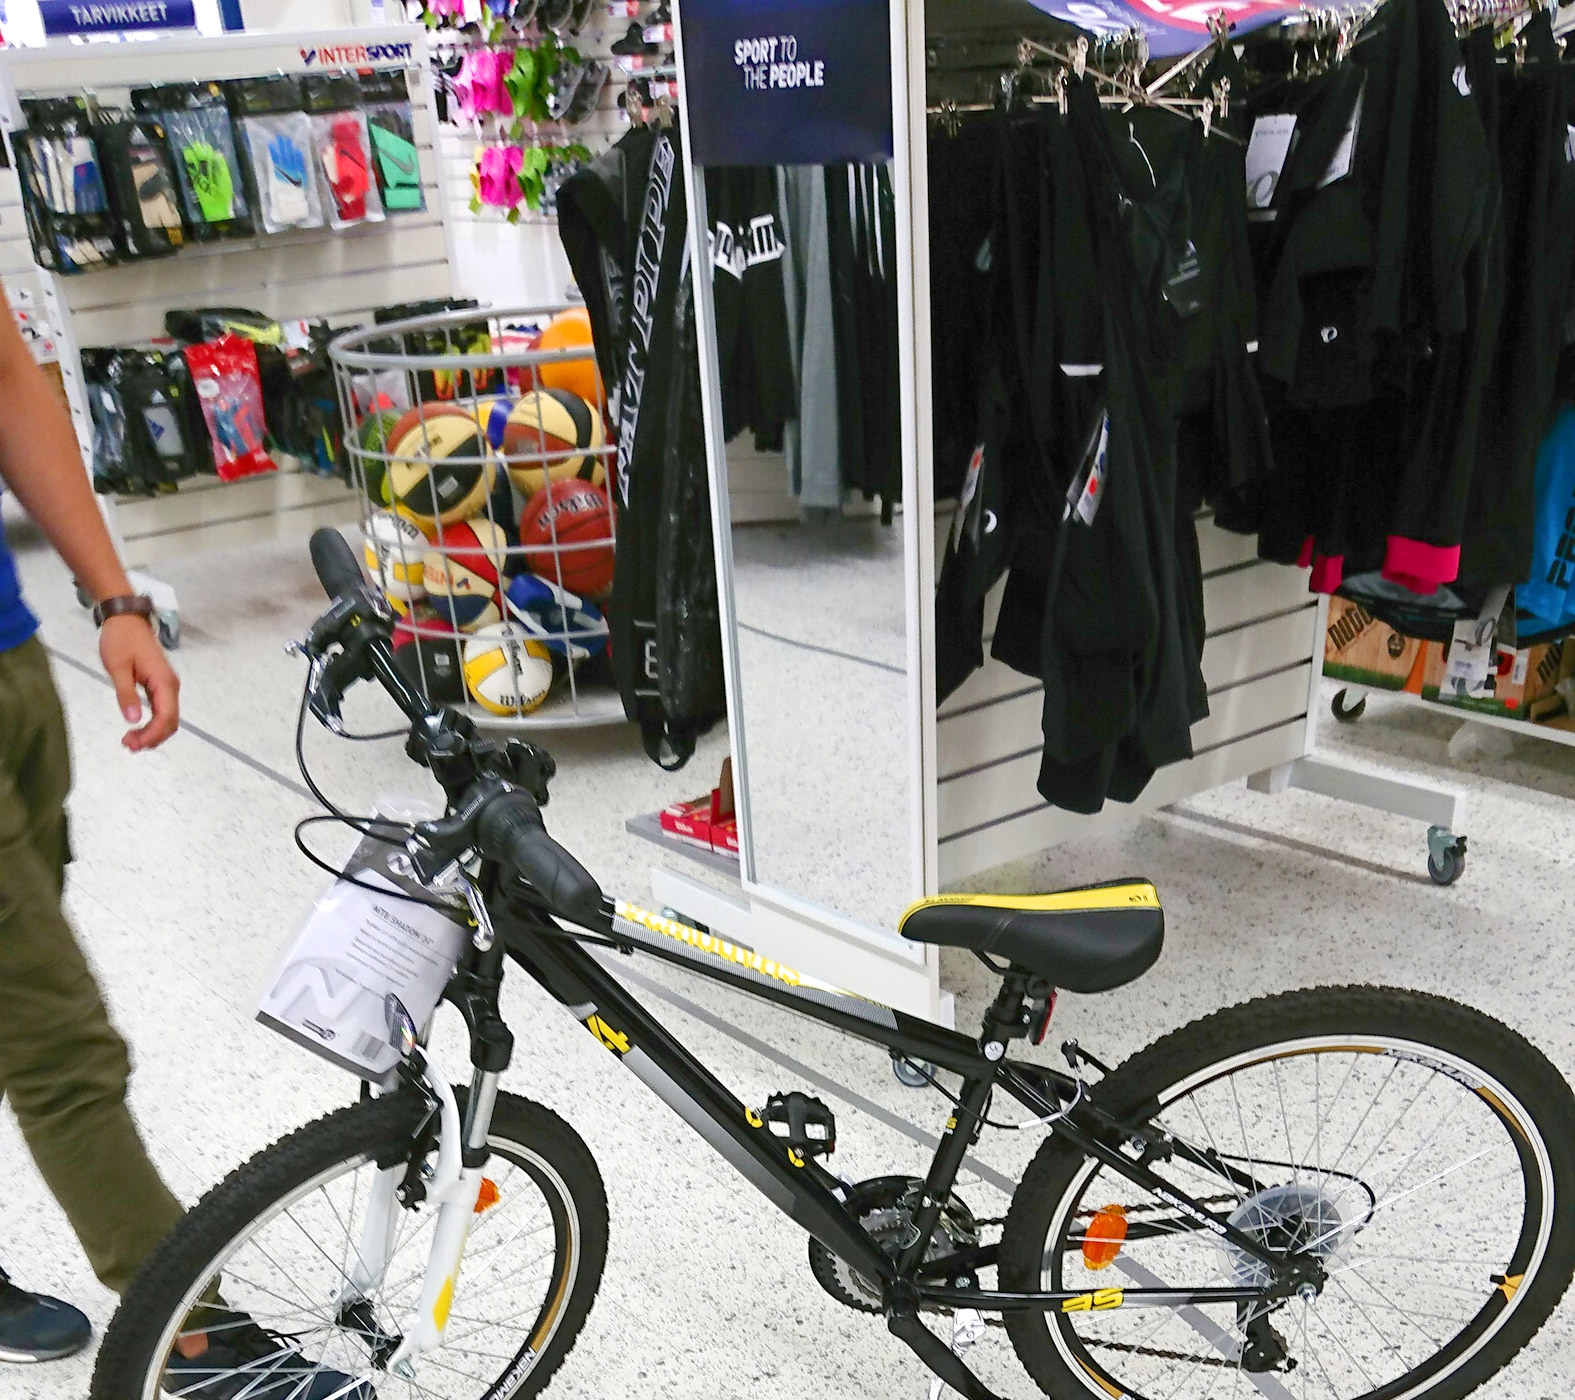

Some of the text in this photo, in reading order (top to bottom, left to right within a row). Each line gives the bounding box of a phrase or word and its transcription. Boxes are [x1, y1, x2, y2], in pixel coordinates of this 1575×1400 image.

[69, 2, 168, 26] TARVIKKEET
[318, 43, 412, 65] INTERSPORT
[734, 34, 797, 65] SPORT TO
[743, 60, 824, 89] THE PEOPLE
